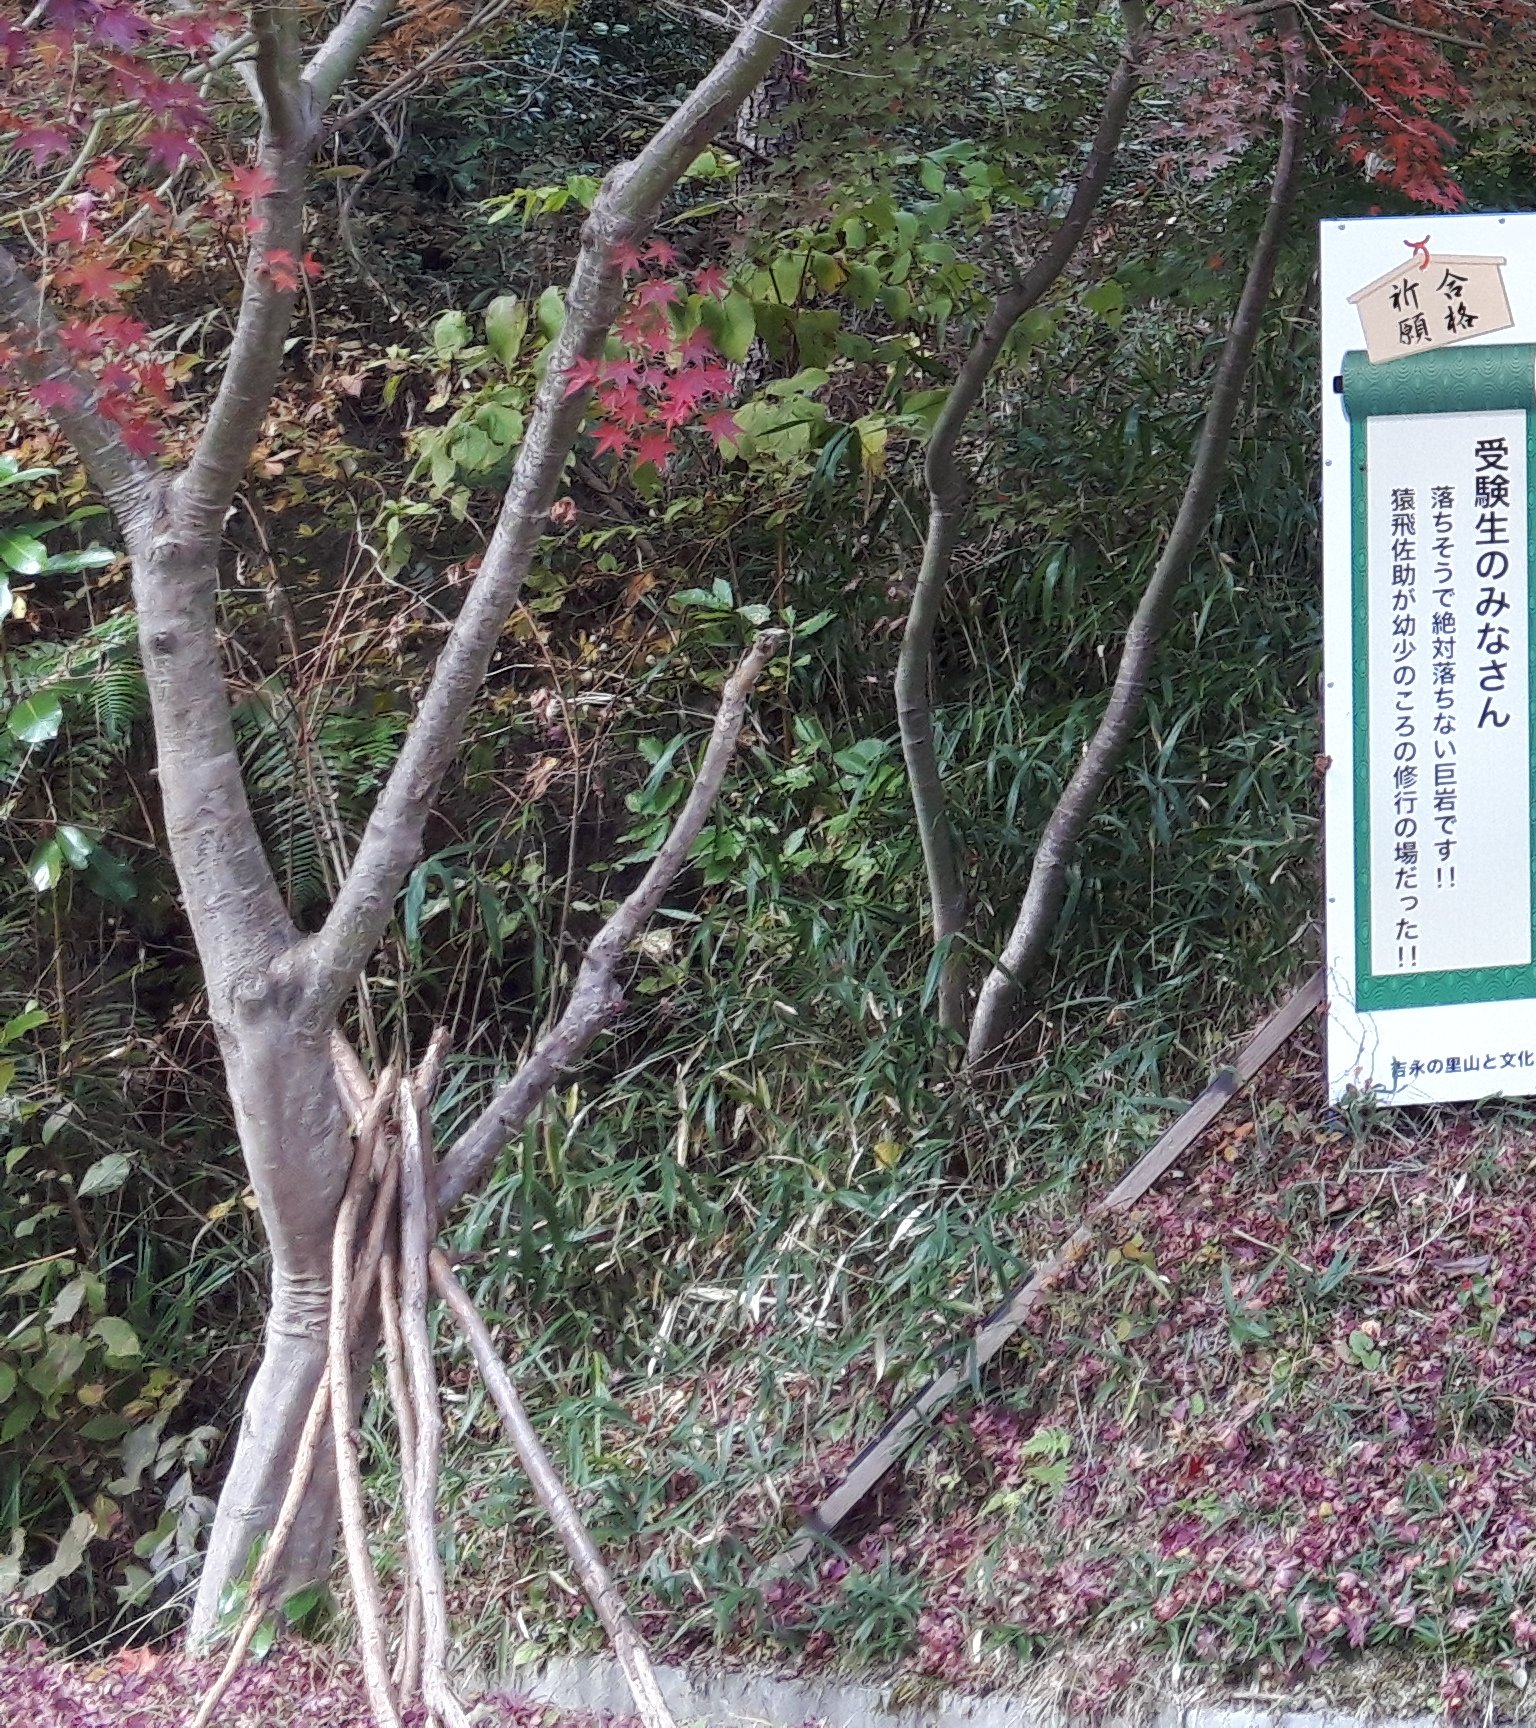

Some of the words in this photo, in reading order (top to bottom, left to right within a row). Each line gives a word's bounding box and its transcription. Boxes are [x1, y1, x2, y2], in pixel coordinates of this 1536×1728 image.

[1389, 278, 1432, 345] 祈願
[1436, 268, 1479, 333] 合格
[1474, 436, 1511, 729] 受験生のみなさん
